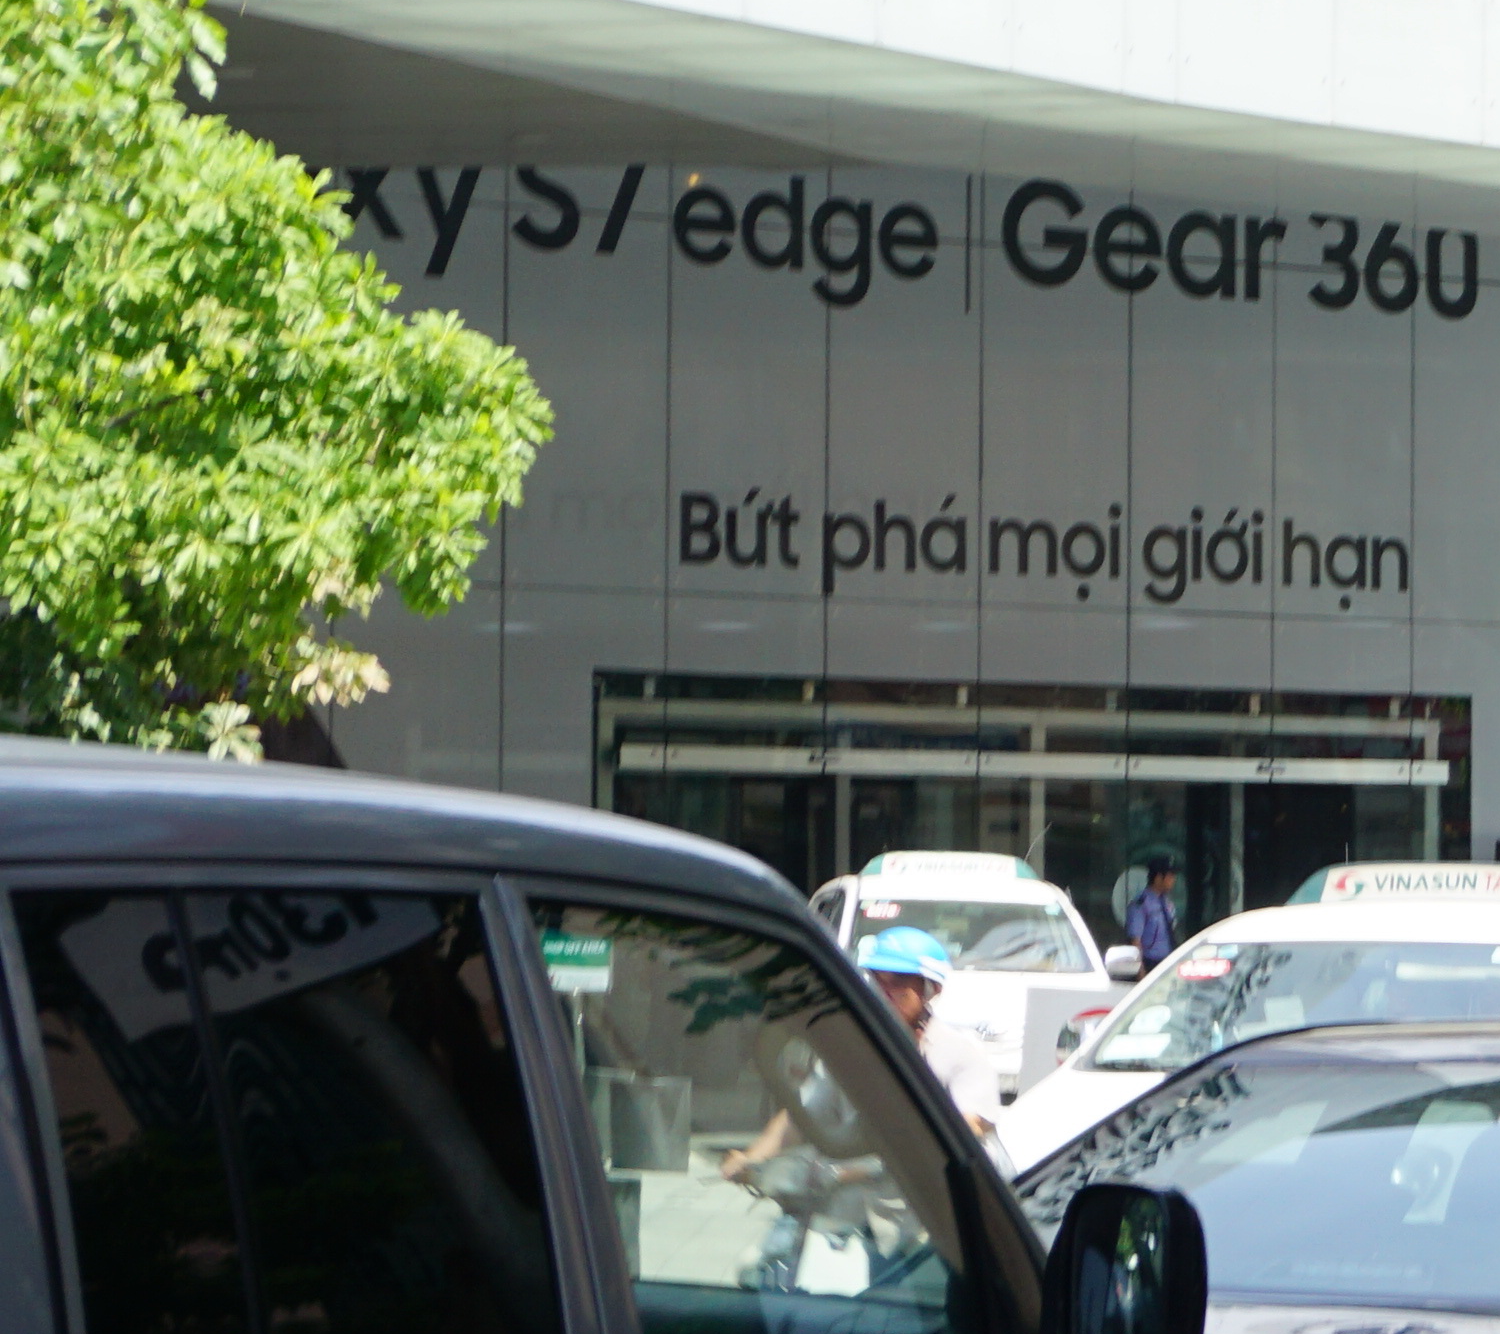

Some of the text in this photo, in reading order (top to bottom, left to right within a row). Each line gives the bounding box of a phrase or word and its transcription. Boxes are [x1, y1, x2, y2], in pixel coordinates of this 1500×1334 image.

[338, 165, 483, 276] xy
[673, 174, 938, 307] edge
[1002, 179, 1287, 303] Gear
[680, 486, 1410, 611] Bứt phá mọi giới hạn
[1374, 873, 1478, 892] VINASUN
